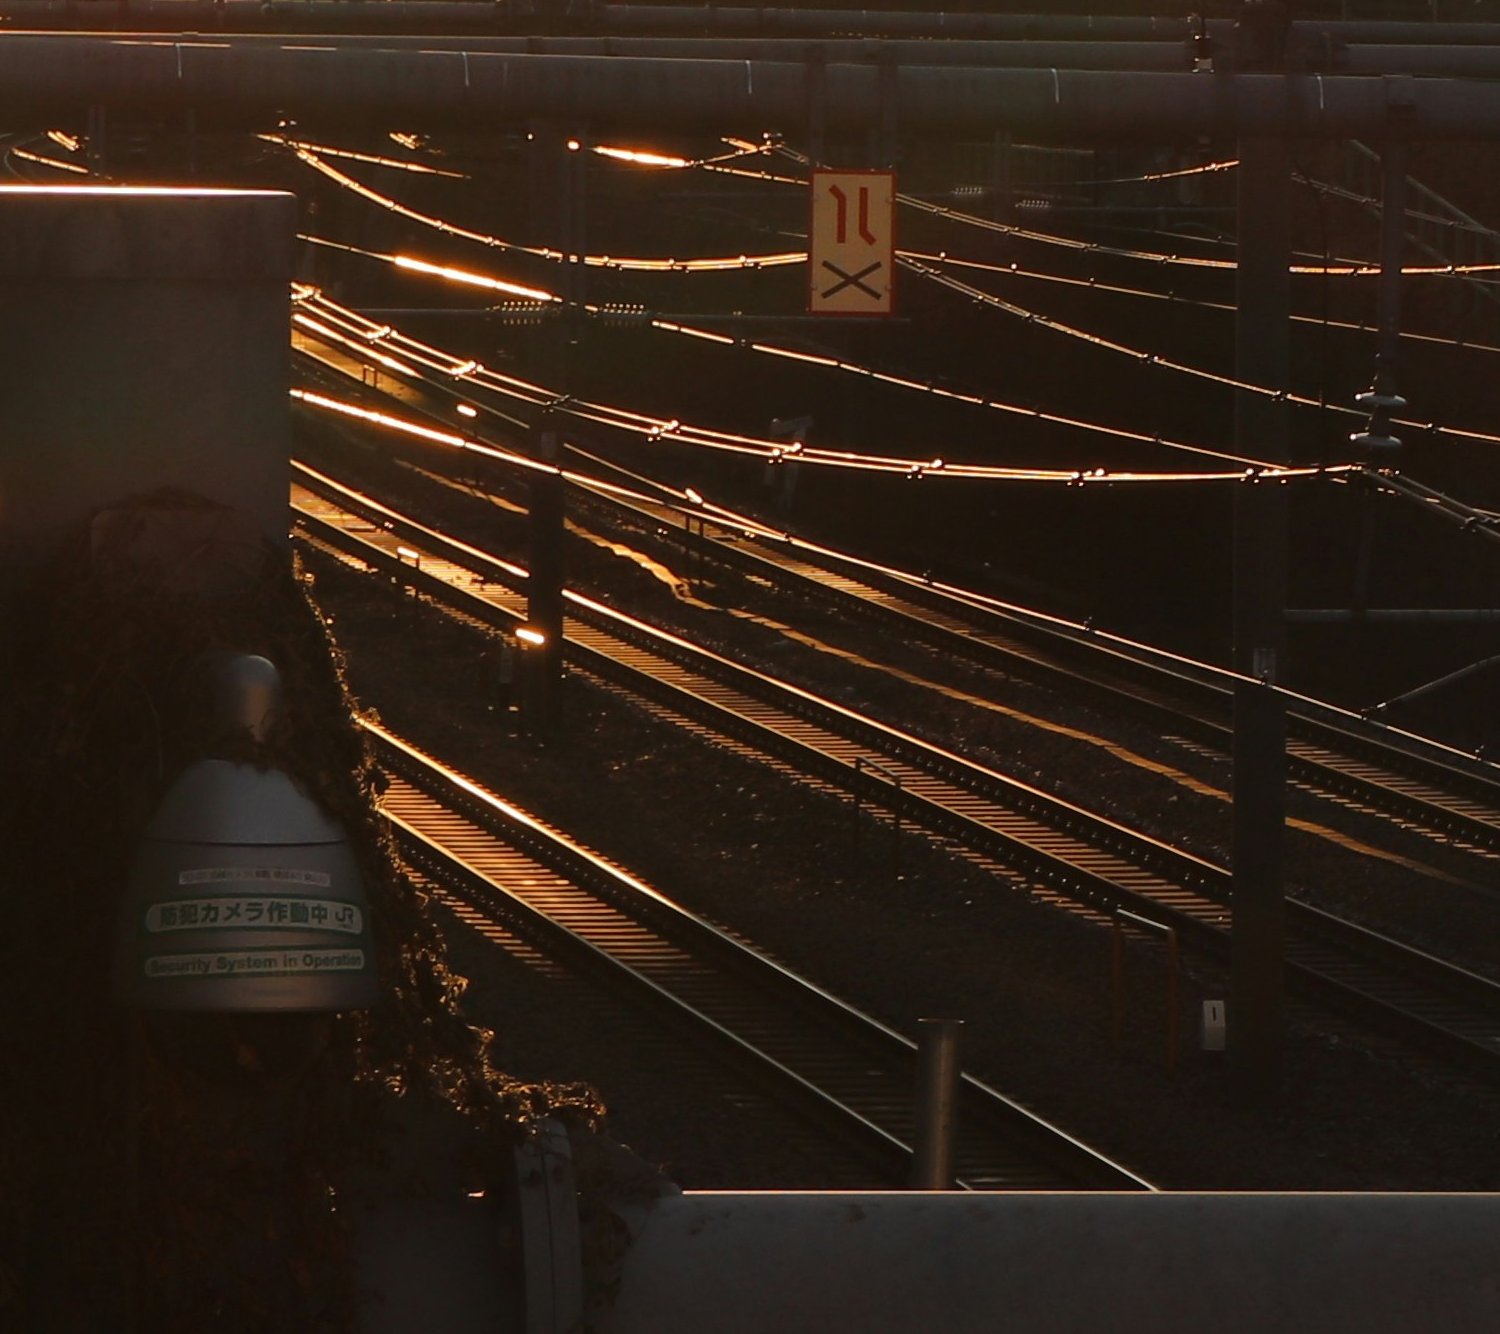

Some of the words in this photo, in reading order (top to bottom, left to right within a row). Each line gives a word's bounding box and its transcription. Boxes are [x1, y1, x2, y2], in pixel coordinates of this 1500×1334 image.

[159, 901, 328, 927] 防犯カメラ作動中
[335, 906, 355, 924] JR
[150, 956, 212, 974] Security
[217, 955, 278, 973] System
[302, 953, 362, 970] Operation
